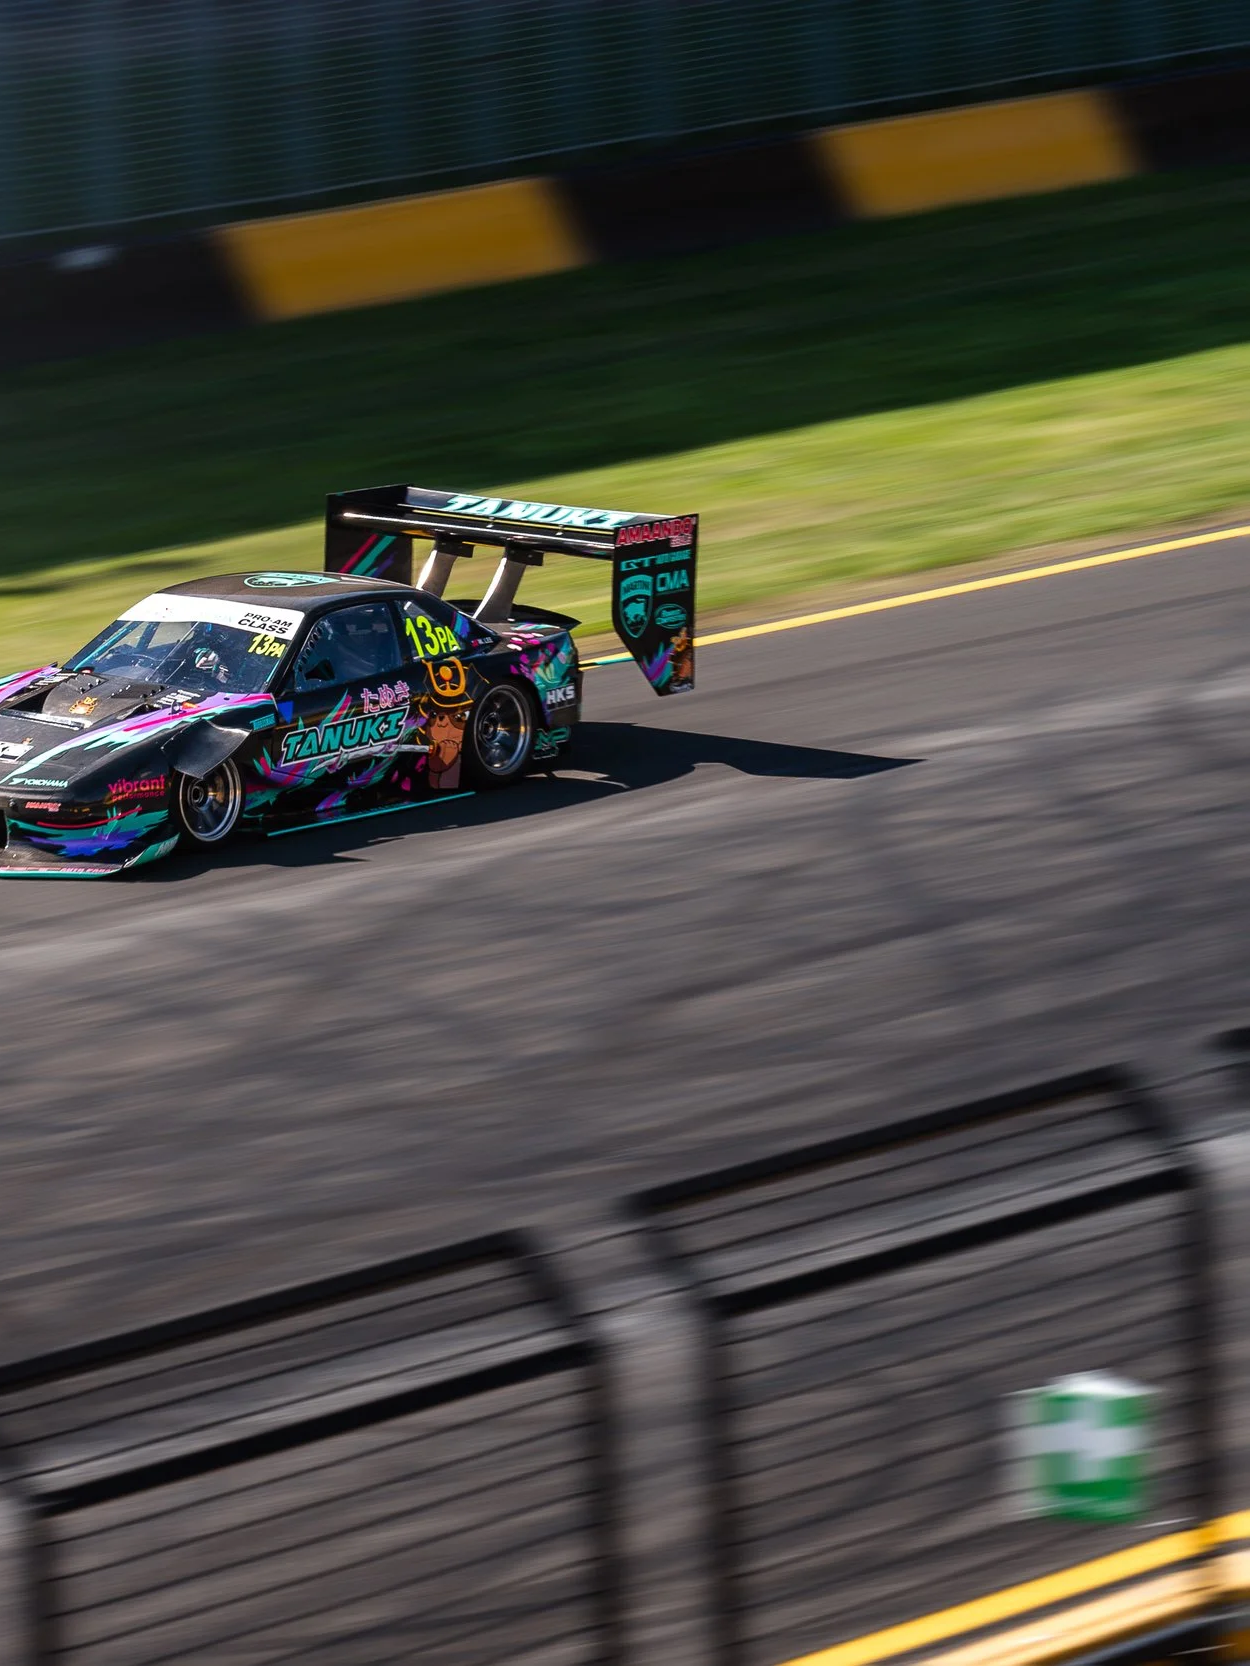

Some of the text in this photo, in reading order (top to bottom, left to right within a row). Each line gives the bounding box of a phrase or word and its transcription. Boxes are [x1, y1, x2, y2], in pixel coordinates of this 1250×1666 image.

[444, 494, 637, 529] TANUKI
[238, 618, 289, 635] CLASS
[405, 615, 461, 658] 13PA
[247, 633, 286, 658] 13PA
[361, 680, 410, 713] たぬき
[546, 685, 575, 705] HKS
[282, 706, 409, 763] TANUKI
[24, 779, 68, 789] YOKOHAMA
[108, 774, 166, 794] vibrant
[112, 790, 165, 803] performance
